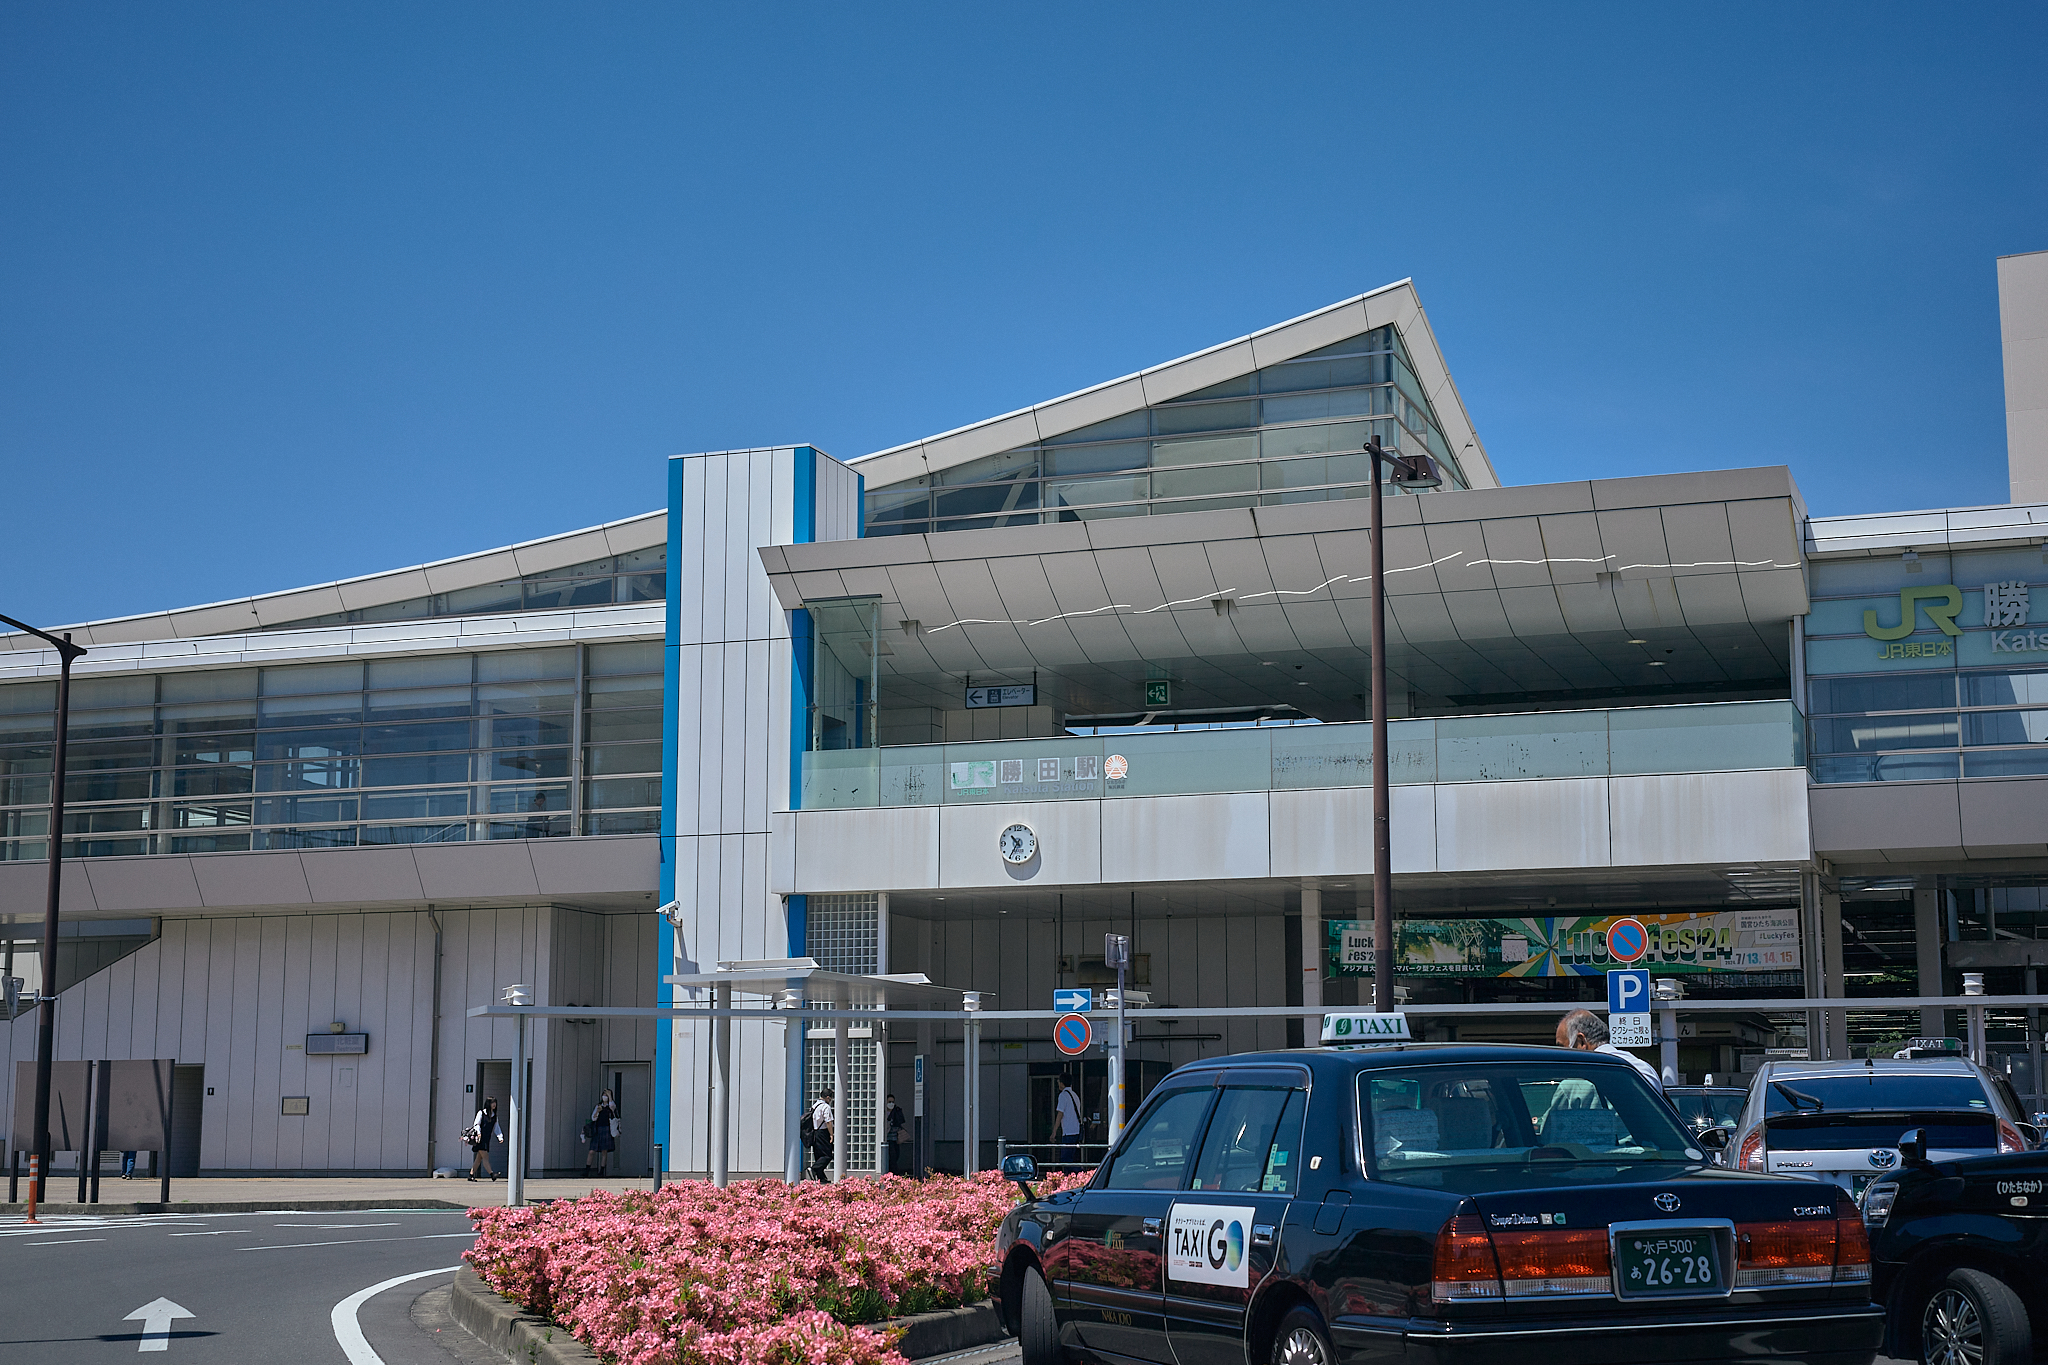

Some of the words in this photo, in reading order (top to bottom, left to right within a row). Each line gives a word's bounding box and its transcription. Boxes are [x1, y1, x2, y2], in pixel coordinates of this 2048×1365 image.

[1984, 580, 2030, 627] 勝
[1864, 584, 1963, 640] JR
[1877, 640, 1953, 659] JR東日本
[1002, 687, 1030, 696] エレベーター
[952, 761, 995, 787] JR
[957, 788, 990, 796] JR東日本
[1004, 783, 1049, 795] Katsuta
[1052, 782, 1094, 793] Station
[1349, 936, 1374, 948] Luck
[1760, 932, 1795, 940] #LuckyFes
[1780, 951, 1793, 962] 15
[1618, 974, 1642, 1009] P
[1355, 1018, 1403, 1034] TAXI
[1611, 1026, 1650, 1034] タクシーに限る
[1611, 1036, 1650, 1044] ここから20m
[1997, 1180, 2042, 1194] (ひたちなか)
[1793, 1206, 1832, 1216] CROWN
[1174, 1228, 1204, 1258] TAXI
[1207, 1219, 1244, 1272] GO
[1630, 1266, 1642, 1280] あ
[1643, 1256, 1711, 1286] 26-28
